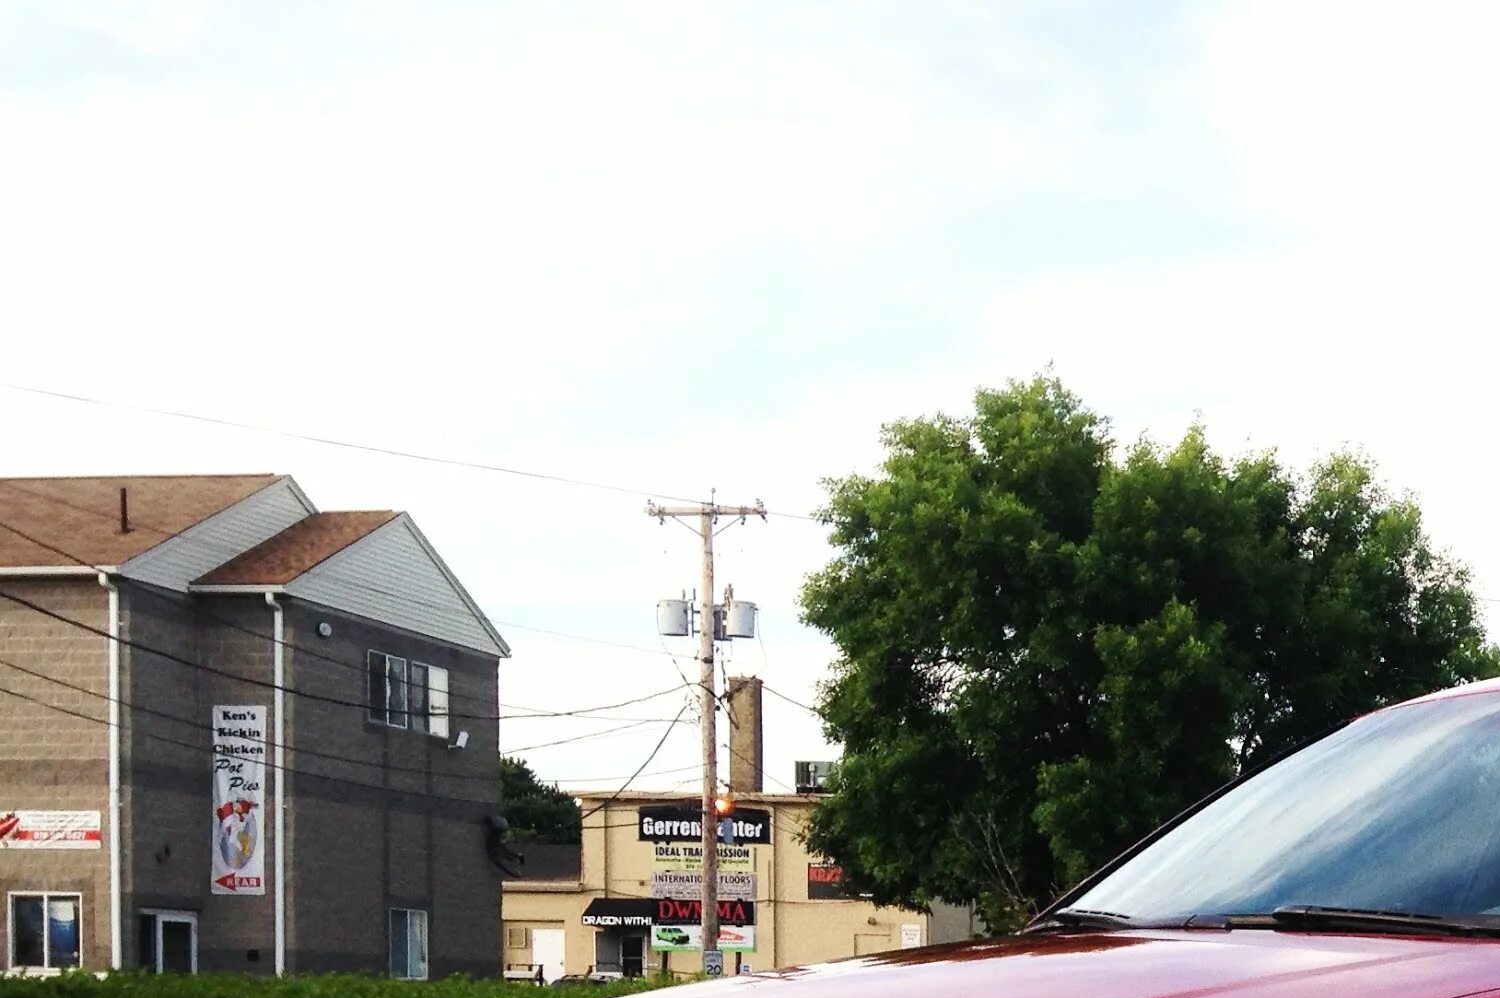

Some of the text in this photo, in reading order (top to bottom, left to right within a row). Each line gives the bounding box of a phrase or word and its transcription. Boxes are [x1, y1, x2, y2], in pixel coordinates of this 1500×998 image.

[222, 711, 257, 721] Ken's
[217, 727, 261, 738] Kickin
[213, 744, 263, 754] Chicken
[215, 759, 244, 773] Pot
[229, 776, 261, 791] Pies
[643, 817, 762, 838] Gerren eter
[655, 847, 749, 858] IDEAL TRAISSION
[655, 874, 751, 884] INTERNATIO FLOORS
[582, 916, 622, 925] DRAGON
[624, 917, 653, 925] WITHI
[706, 965, 721, 975] 20
